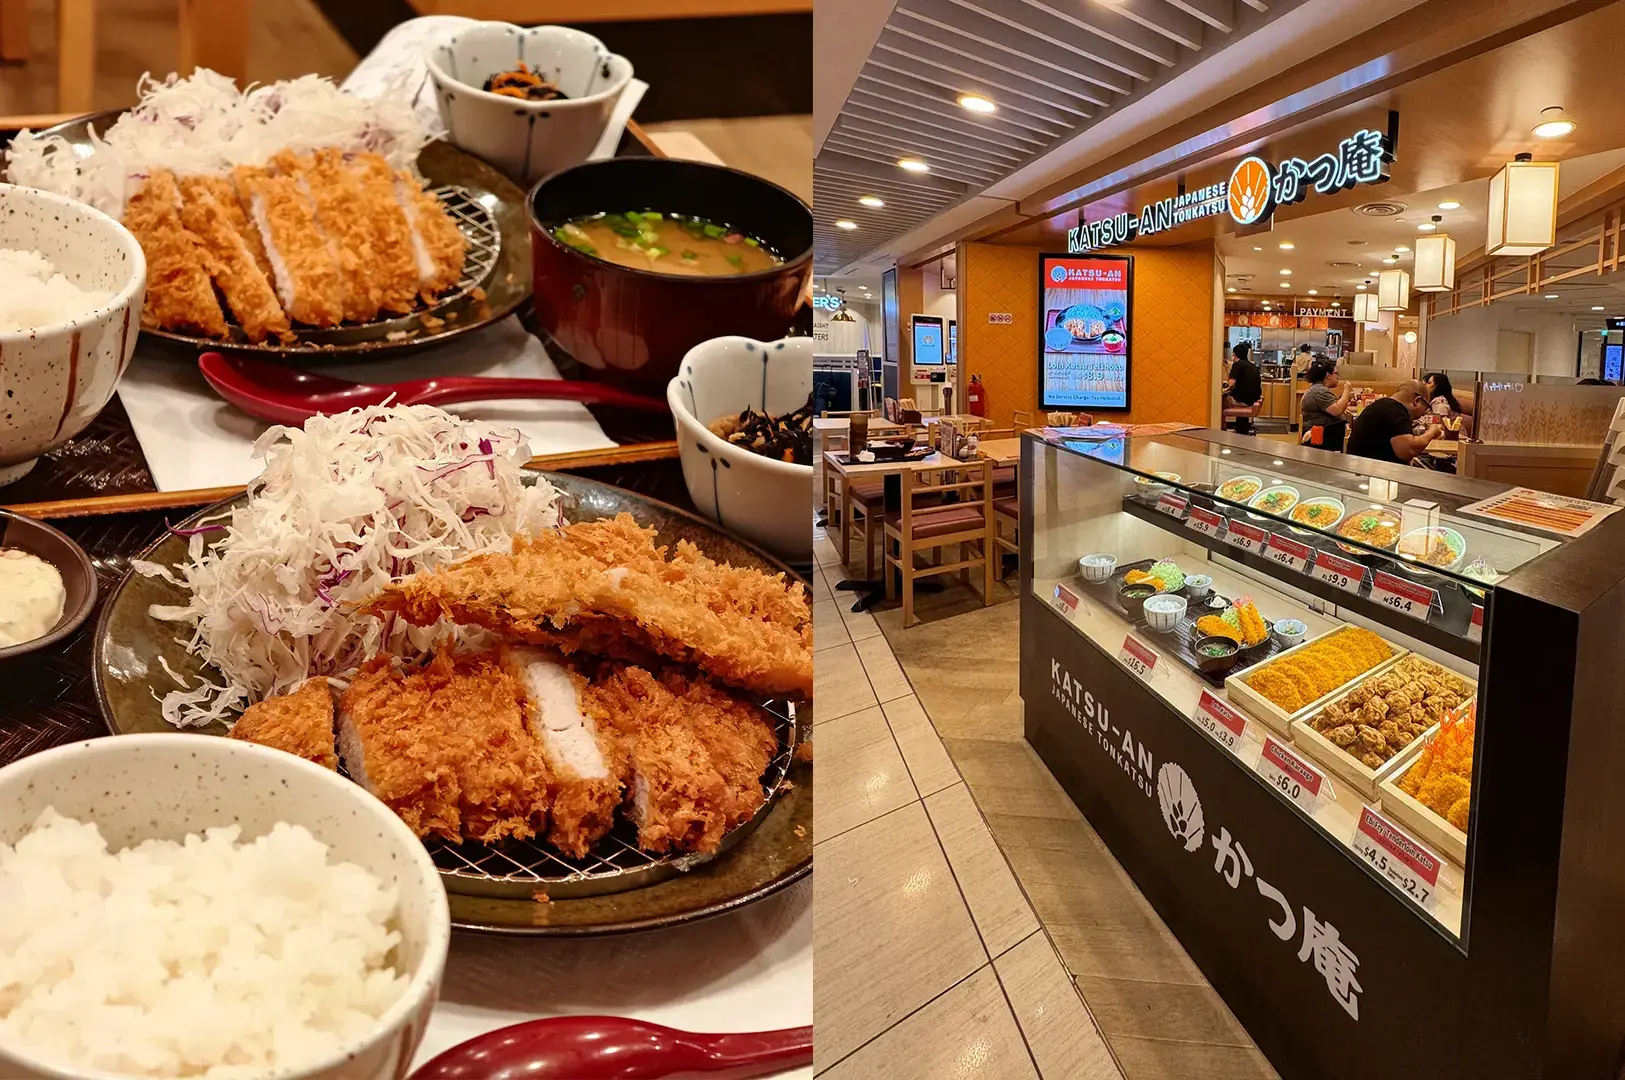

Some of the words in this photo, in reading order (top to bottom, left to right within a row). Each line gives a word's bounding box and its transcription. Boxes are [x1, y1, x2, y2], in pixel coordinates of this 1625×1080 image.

[1273, 129, 1384, 203] かつ庵
[1173, 182, 1226, 209] JAPANESE
[1068, 198, 1172, 253] KATSU-AN
[1173, 199, 1226, 225] TONKATSU
[1068, 268, 1122, 278] KATSU-AN
[1300, 307, 1348, 317] PAYMENT
[1278, 553, 1295, 566] $6.4
[1328, 574, 1348, 587] $9.9
[1388, 596, 1412, 612] $6.4
[1127, 657, 1146, 675] $16.5
[1051, 657, 1153, 780] KATSU-AN
[1201, 717, 1216, 732] $5.0
[1219, 731, 1234, 747] $3.9
[1051, 684, 1094, 736] JAPANESE
[1096, 730, 1153, 799] TONKATSU
[1276, 774, 1301, 799] $6.0
[1365, 814, 1374, 827] Ebi
[1374, 820, 1383, 834] Fry
[1385, 828, 1416, 857] Tenderloin
[1415, 850, 1433, 872] Katsu
[1363, 846, 1388, 870] $4.5
[1402, 877, 1430, 903] $2.7
[1211, 825, 1364, 1022] かつ庵
